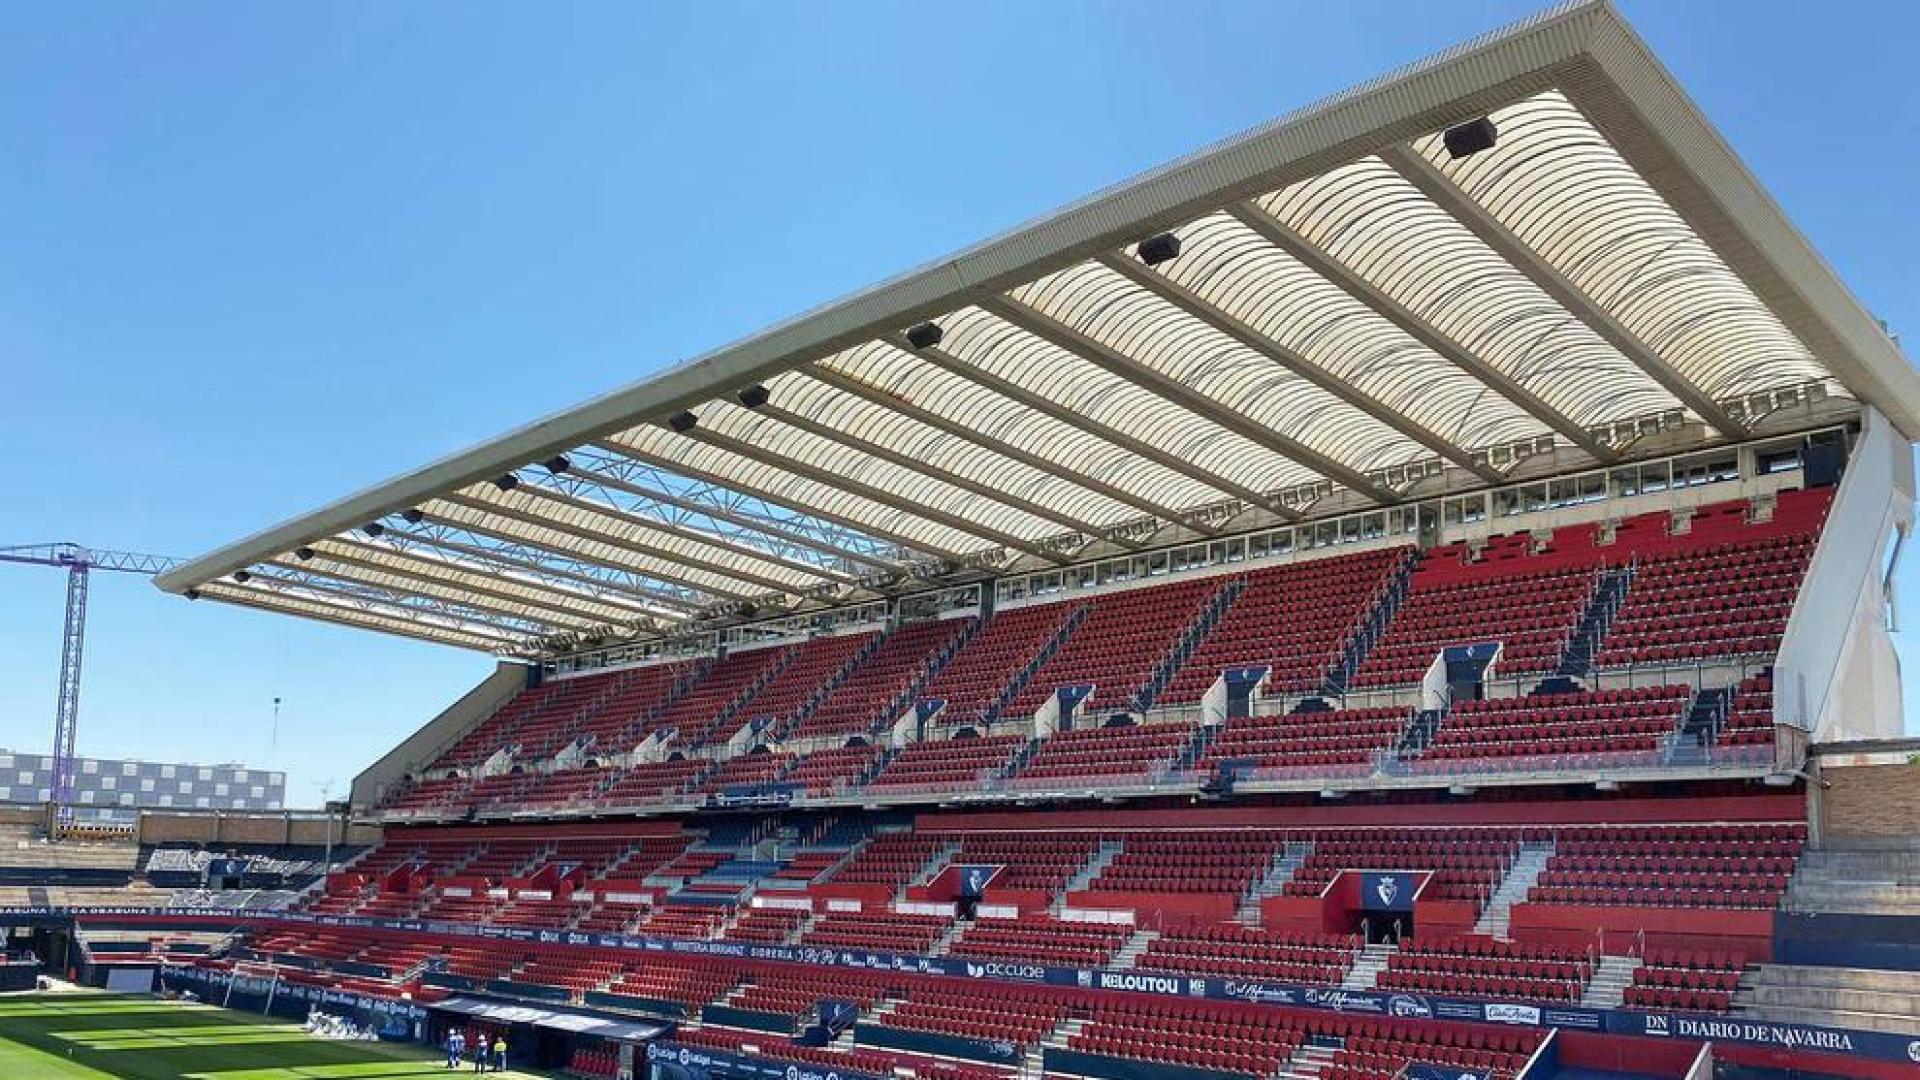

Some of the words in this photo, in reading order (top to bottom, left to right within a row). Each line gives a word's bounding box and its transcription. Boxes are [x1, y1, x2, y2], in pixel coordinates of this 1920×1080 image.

[1645, 1015, 1668, 1029] DN
[1677, 1019, 1741, 1039] DIARIO
[1743, 1024, 1770, 1042] DE
[1771, 1027, 1853, 1050] NAVARRA
